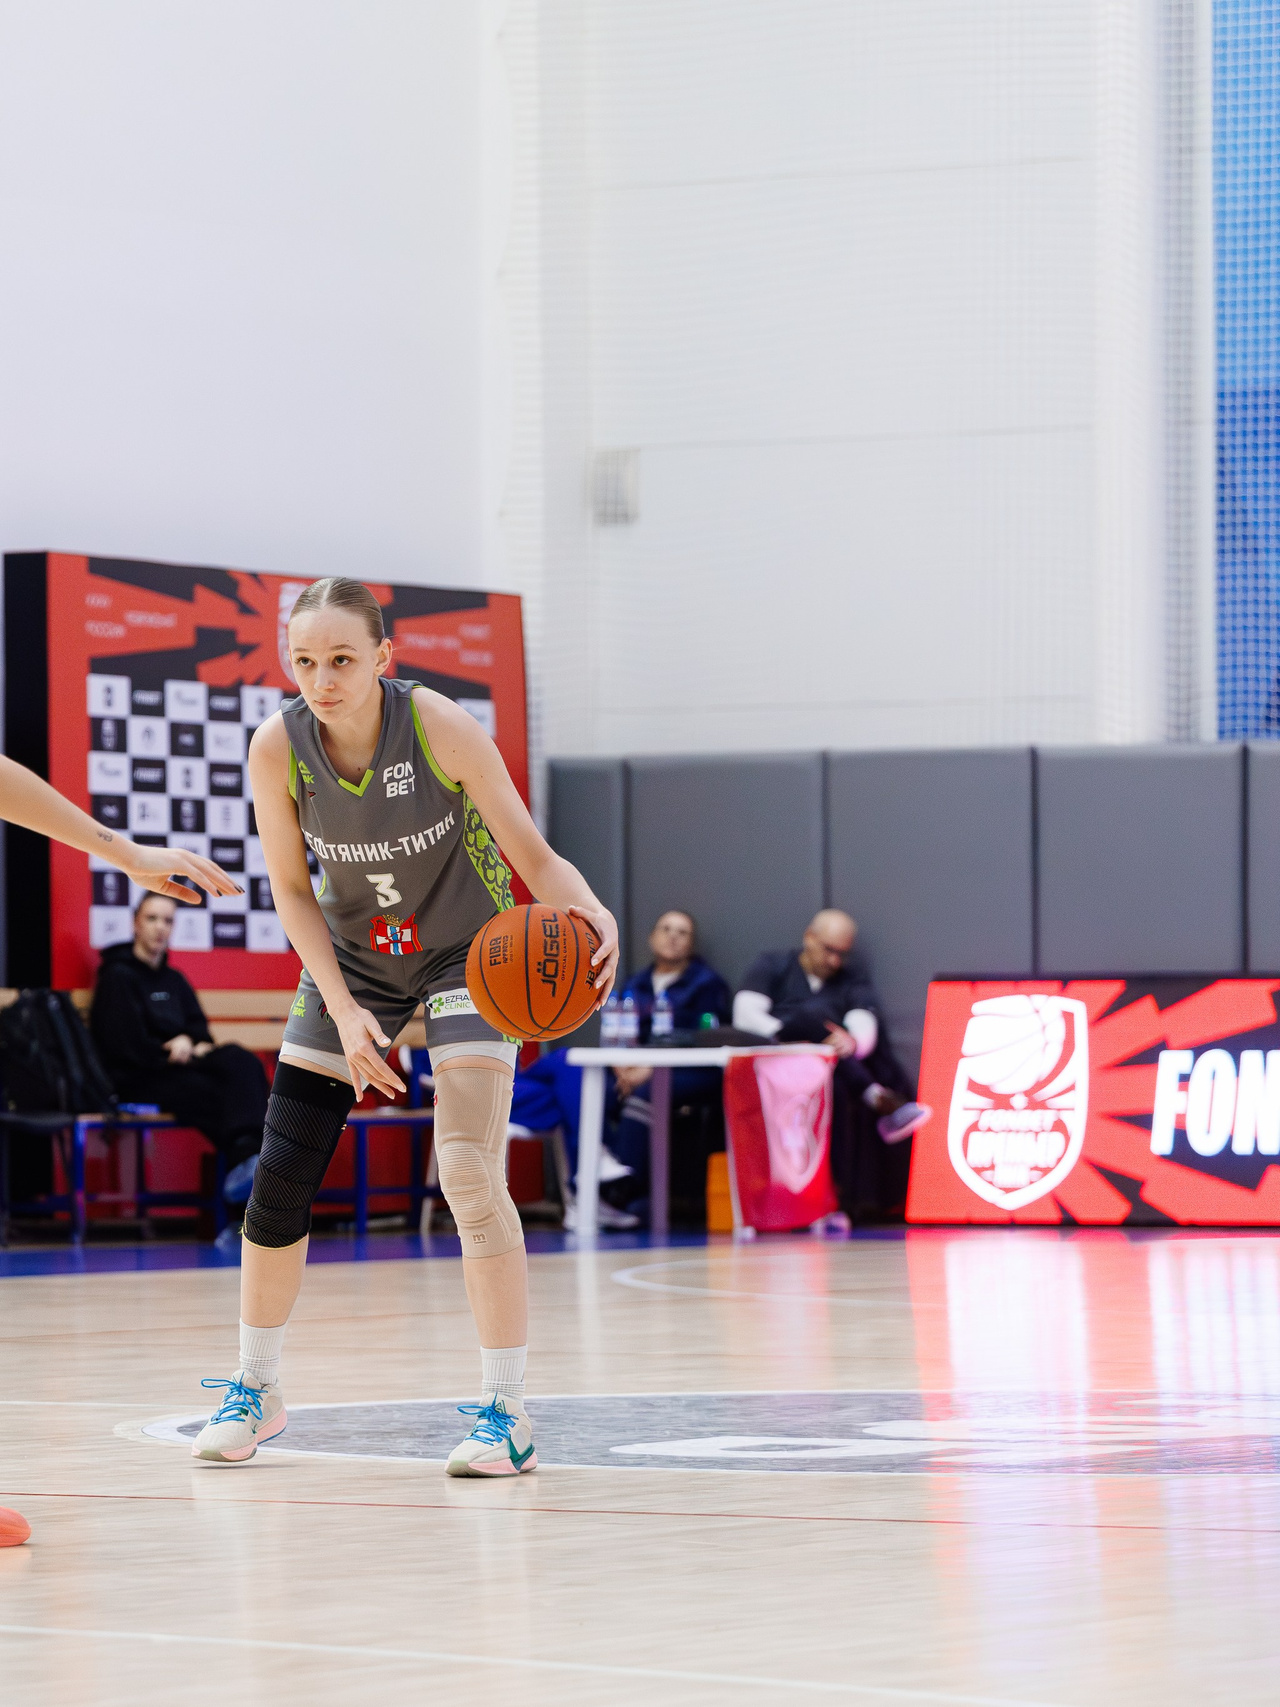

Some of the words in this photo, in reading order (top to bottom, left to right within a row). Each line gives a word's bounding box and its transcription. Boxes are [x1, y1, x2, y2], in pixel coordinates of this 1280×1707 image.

[382, 761, 413, 783] FON
[386, 774, 415, 798] BET
[301, 811, 455, 862] ЕФТЯНИК-ТИТАН
[366, 873, 402, 908] 3
[536, 912, 560, 998] JÖGEL
[445, 994, 470, 1003] EZRA
